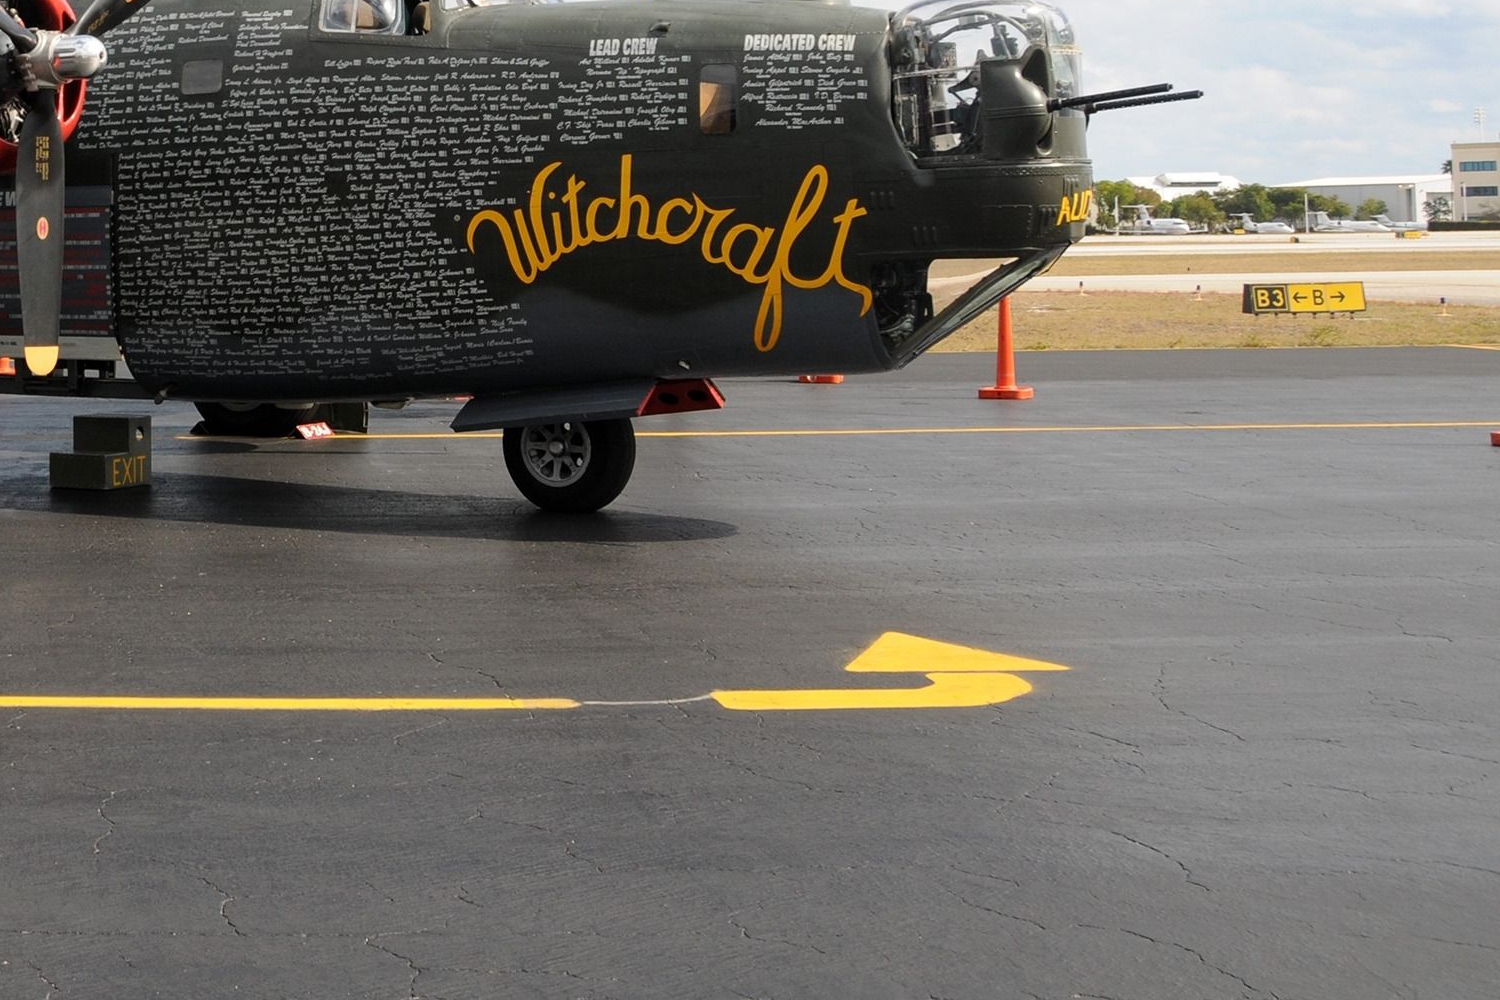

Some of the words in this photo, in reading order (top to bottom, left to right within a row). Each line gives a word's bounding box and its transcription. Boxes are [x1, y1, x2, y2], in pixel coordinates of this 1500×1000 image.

[589, 38, 620, 56] LEAD
[622, 37, 658, 55] CREW
[744, 34, 815, 51] DEDICATED
[818, 34, 856, 51] CREW
[631, 92, 652, 100] Robert
[765, 104, 792, 112] Richard
[467, 154, 873, 352] Witchcraft
[1257, 290, 1284, 307] B3
[1312, 290, 1324, 306] B
[112, 455, 146, 486] EXIT
